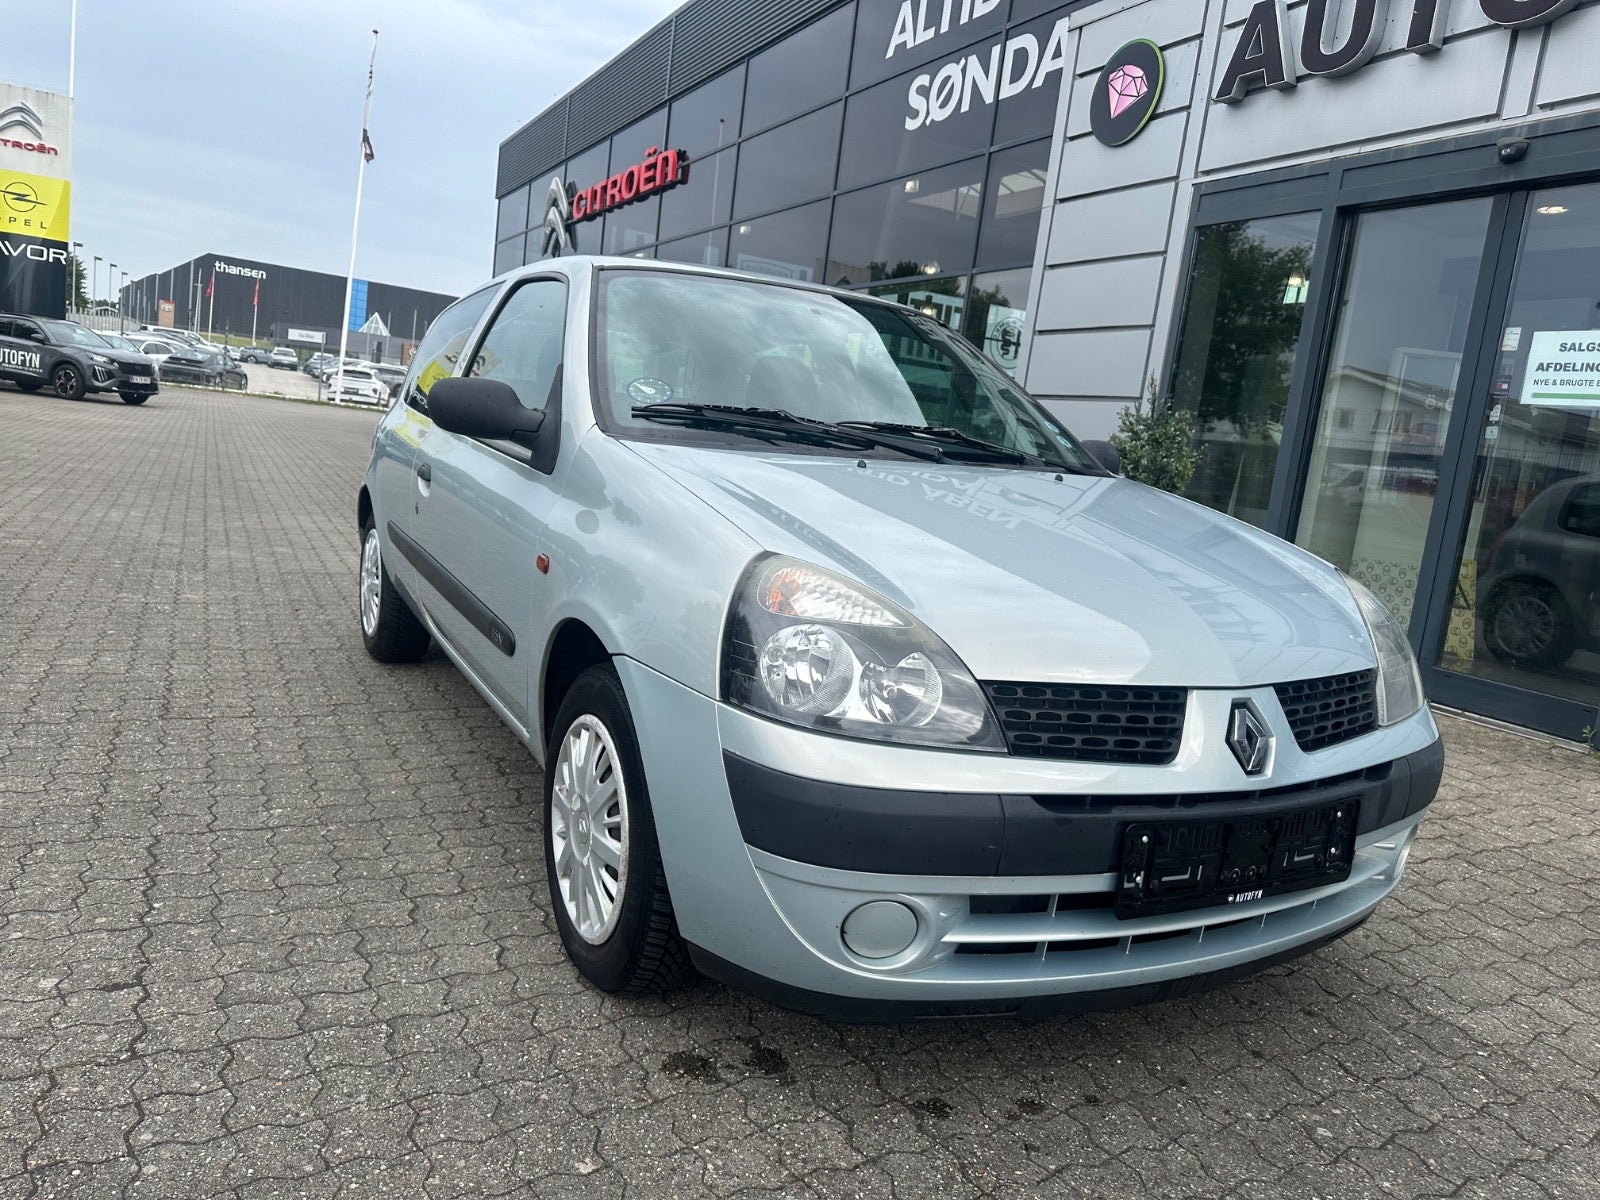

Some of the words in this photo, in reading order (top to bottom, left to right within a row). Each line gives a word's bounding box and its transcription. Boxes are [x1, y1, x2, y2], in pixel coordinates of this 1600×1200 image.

[1213, 0, 1572, 103] AU
[572, 145, 678, 220] CITROËN
[0, 215, 48, 230] PEL
[214, 260, 267, 280] thansen
[1533, 378, 1549, 386] NYE
[1559, 379, 1594, 387] BRUGTE
